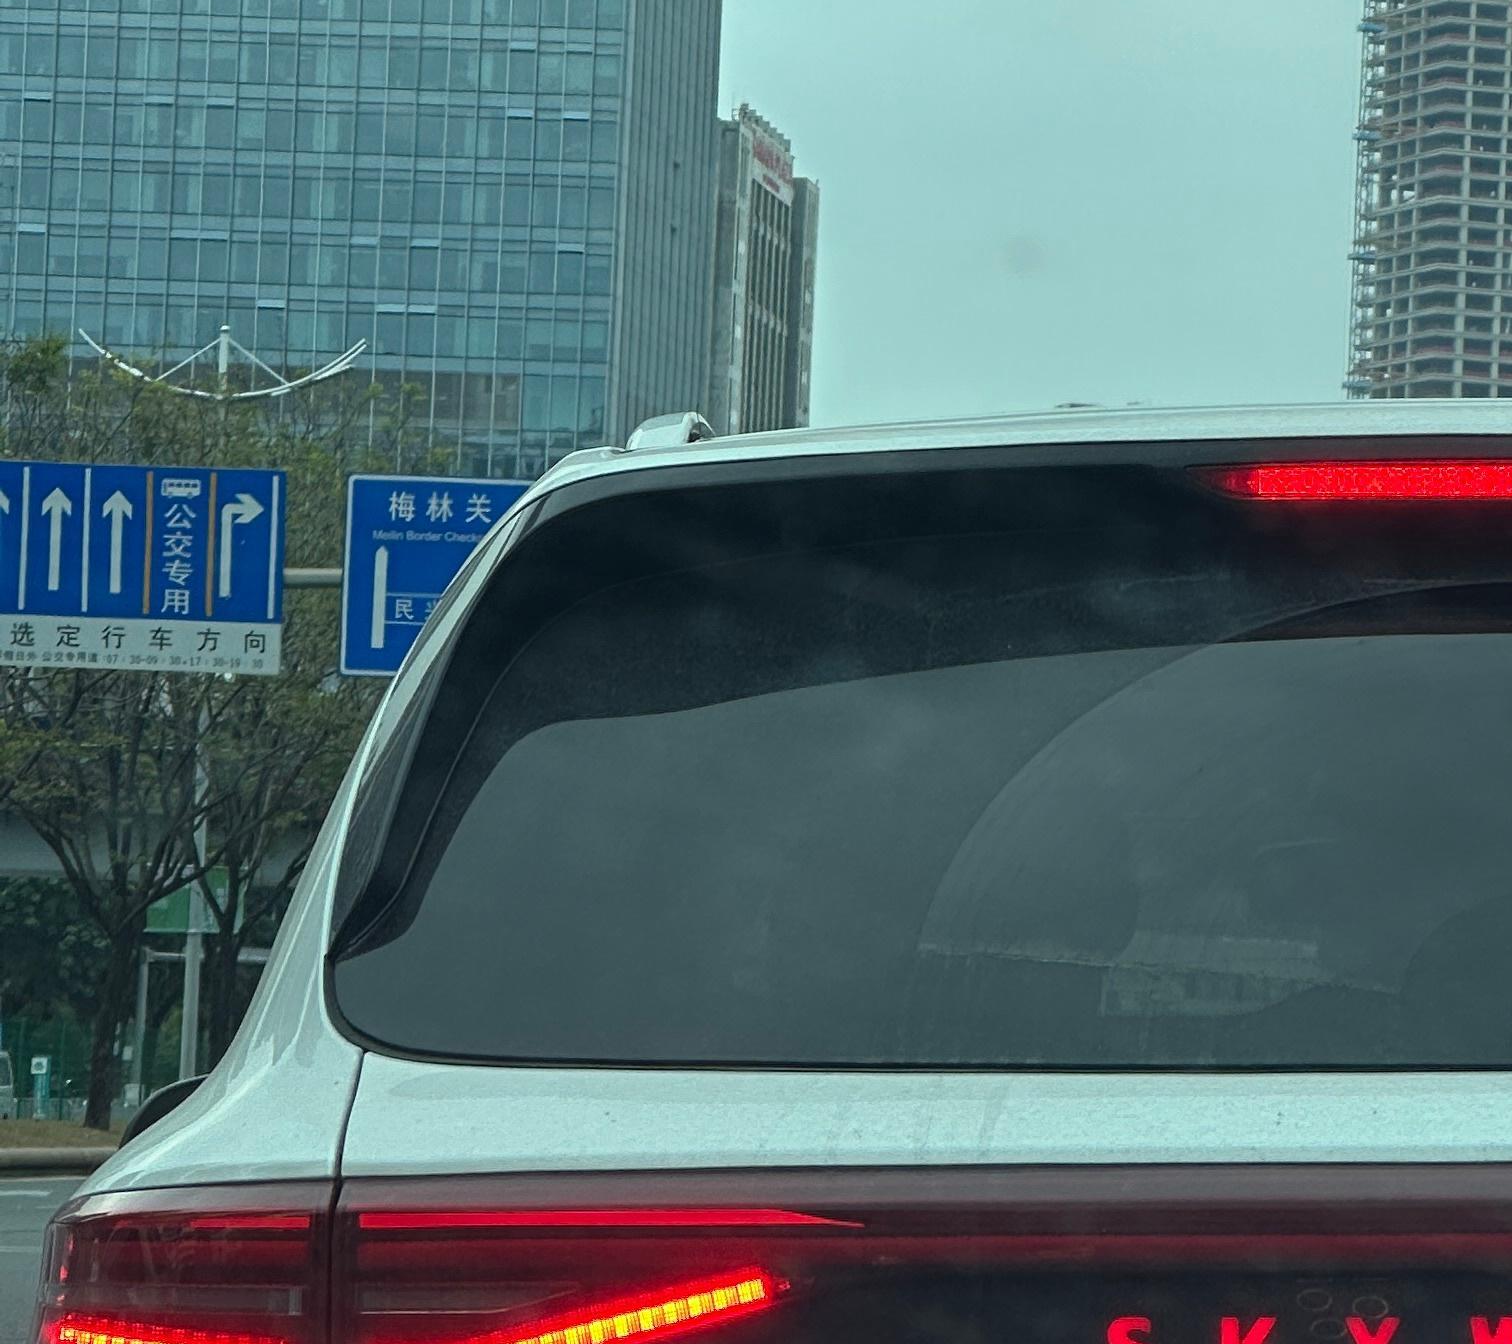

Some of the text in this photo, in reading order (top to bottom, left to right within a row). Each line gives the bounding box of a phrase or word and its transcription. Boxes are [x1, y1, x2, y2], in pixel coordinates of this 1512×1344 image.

[388, 490, 492, 524] 梅林关
[405, 530, 443, 543] Border
[161, 503, 197, 615] 公交专用
[10, 621, 267, 655] 选定行车方向
